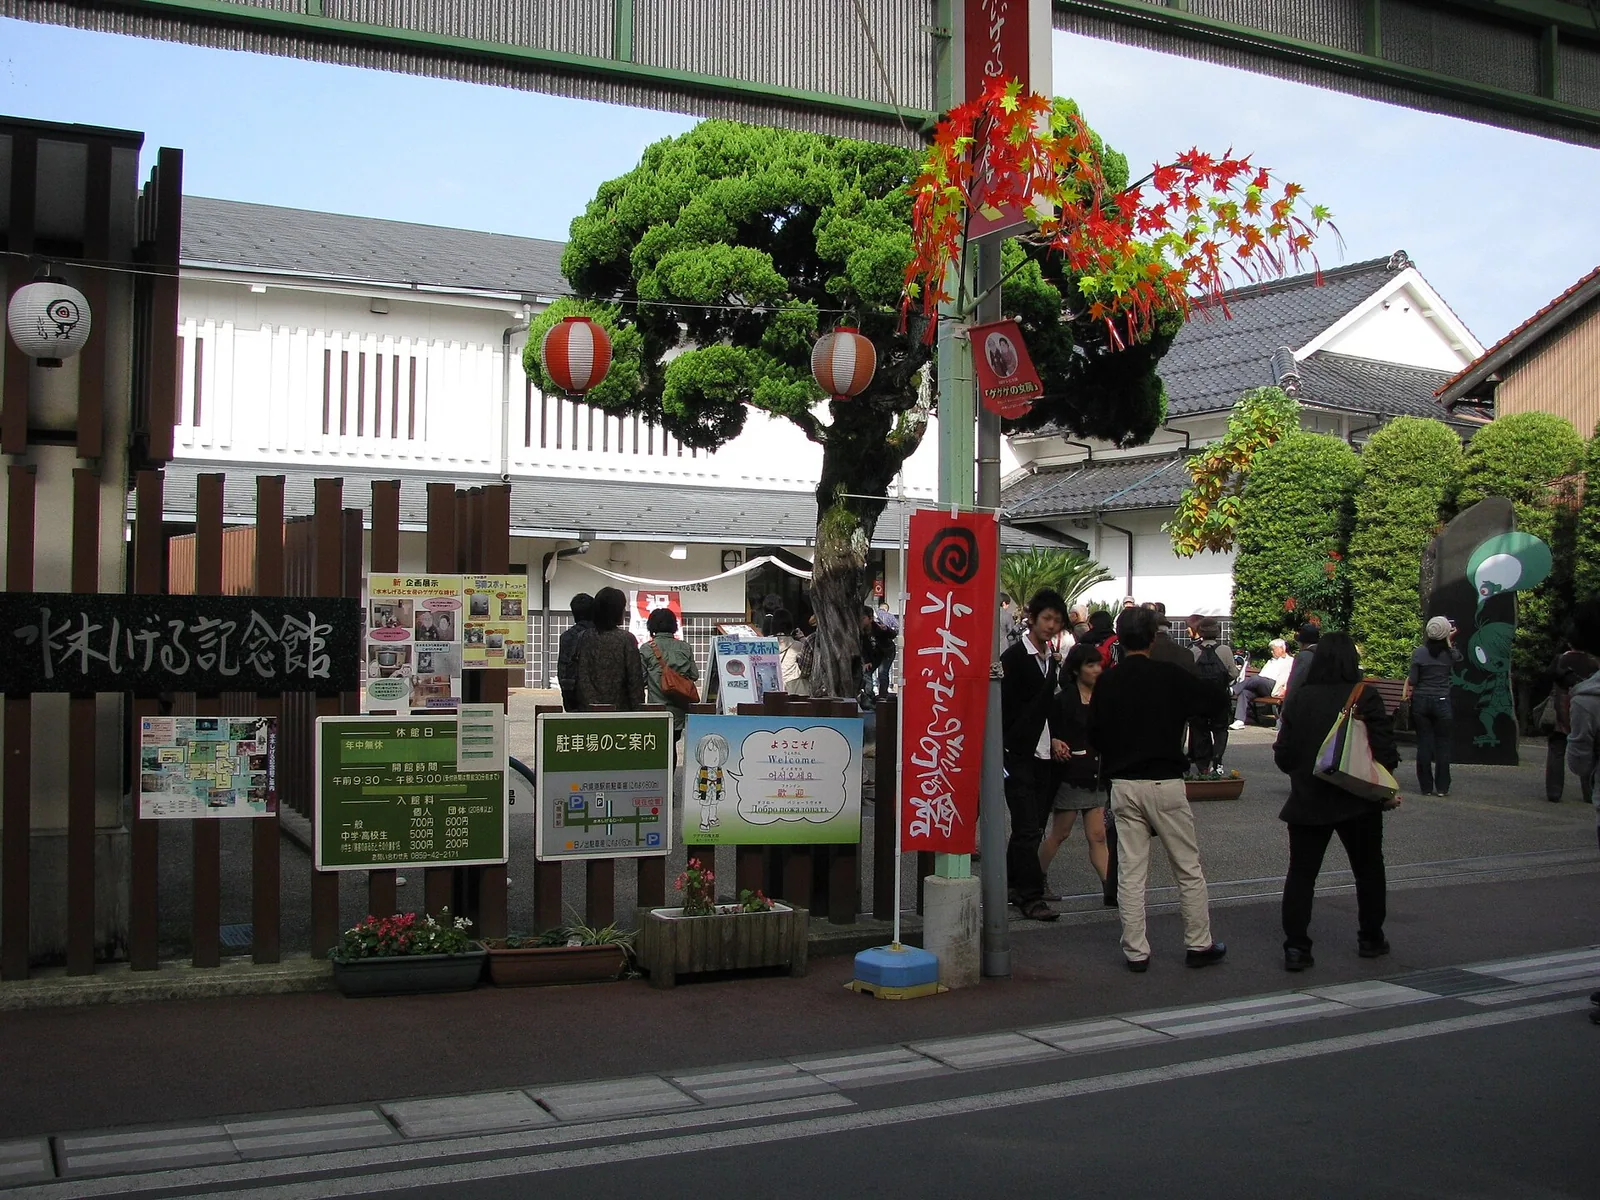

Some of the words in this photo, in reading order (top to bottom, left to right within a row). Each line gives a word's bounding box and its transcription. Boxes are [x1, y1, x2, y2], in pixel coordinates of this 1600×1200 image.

[393, 578, 401, 587] 新
[406, 578, 439, 587] 企画展示
[14, 606, 334, 679] 水木しげる記念館
[717, 642, 779, 656] 写真スポット
[396, 727, 434, 738] 休館日
[345, 740, 384, 750] 年中無休
[555, 732, 657, 753] 駐車場のご案内
[768, 755, 816, 765] Welcome
[392, 762, 438, 772] 開館時間
[333, 775, 380, 786] 午前9:30
[395, 774, 442, 785] 午後5:00
[768, 771, 815, 781] 어서오세요
[397, 795, 434, 805] 入館料
[412, 808, 432, 817] 個人
[448, 806, 466, 815] 団体
[751, 804, 778, 815] Добро
[342, 819, 364, 829] 一般
[410, 817, 434, 827] 700円
[445, 816, 469, 826] 600円
[409, 829, 434, 839] 500円
[445, 828, 469, 838] 400円
[409, 840, 434, 850] 300円
[445, 839, 469, 849] 200円
[410, 851, 459, 860] 0859-42-2171
